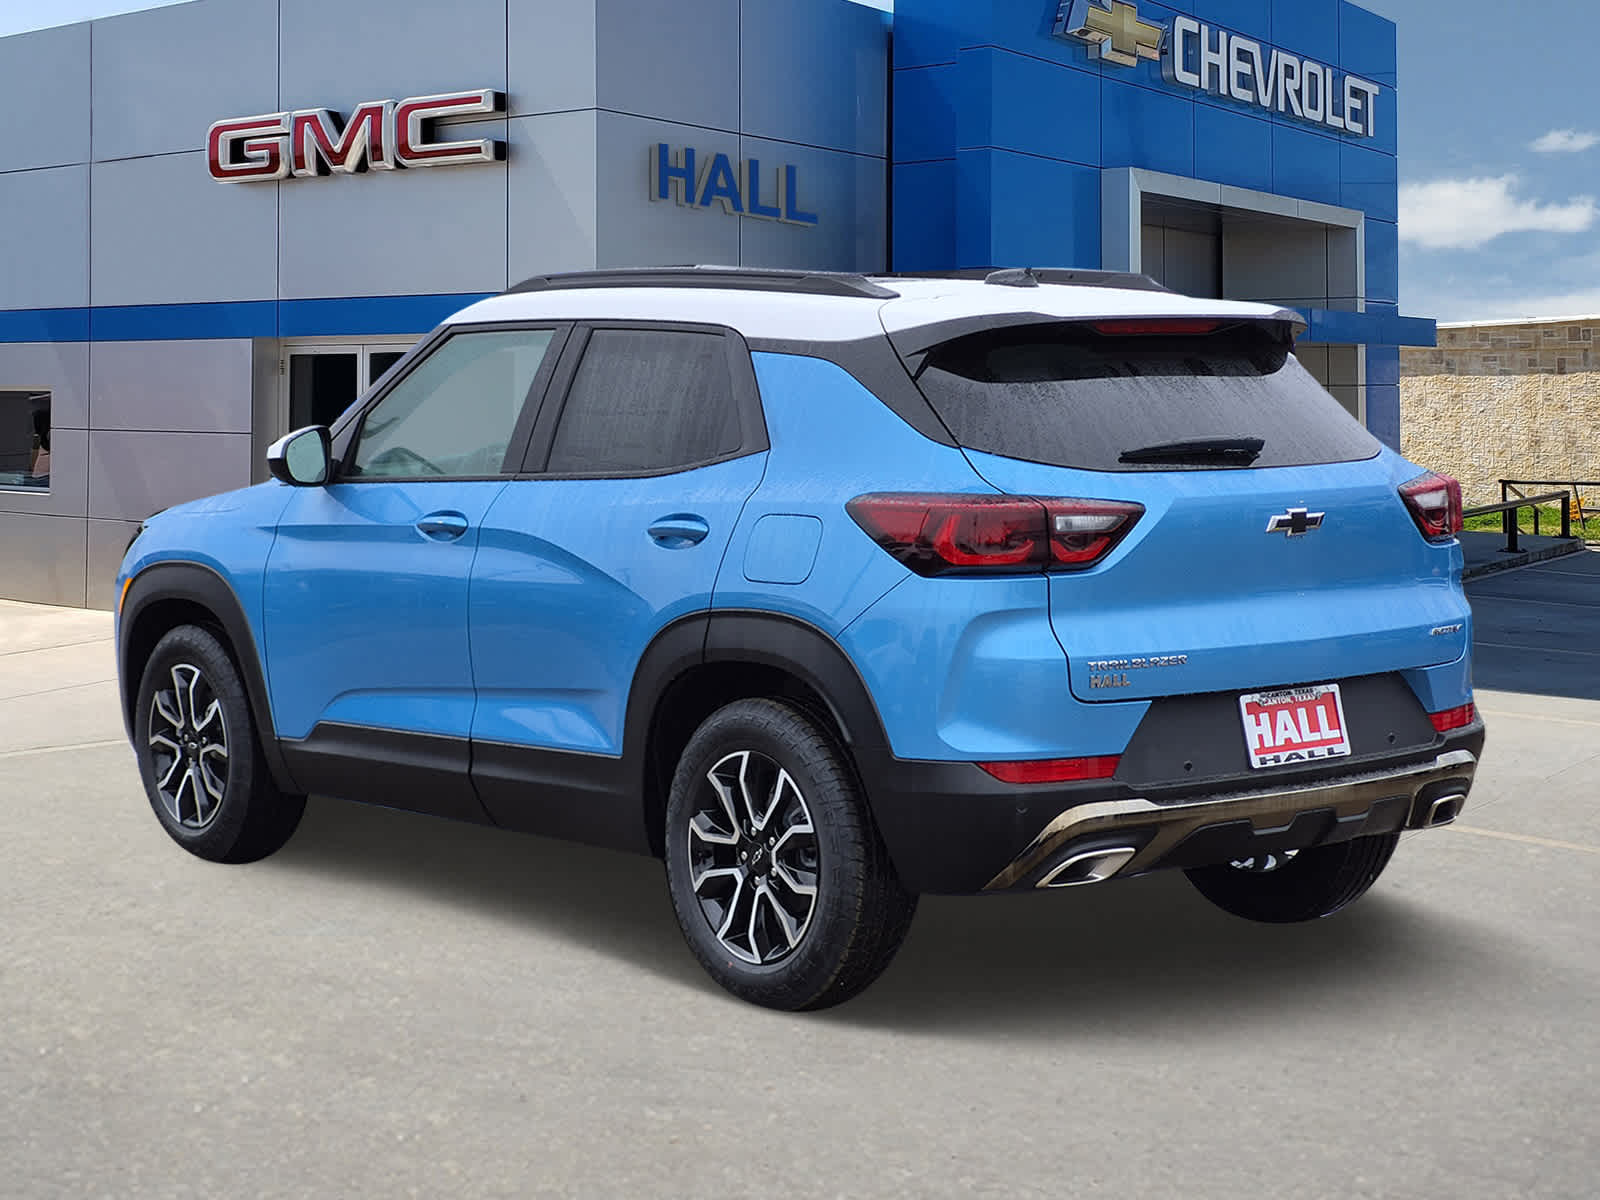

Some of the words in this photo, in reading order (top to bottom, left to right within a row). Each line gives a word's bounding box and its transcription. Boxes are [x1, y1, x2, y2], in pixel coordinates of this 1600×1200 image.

[1173, 15, 1379, 137] CHEVROLET
[207, 88, 507, 184] GMC
[650, 142, 819, 226] HALL
[1087, 654, 1188, 672] TRAILBLAZER
[1089, 673, 1131, 688] HALL
[1247, 704, 1341, 749] HALL
[1260, 746, 1345, 765] HALL
